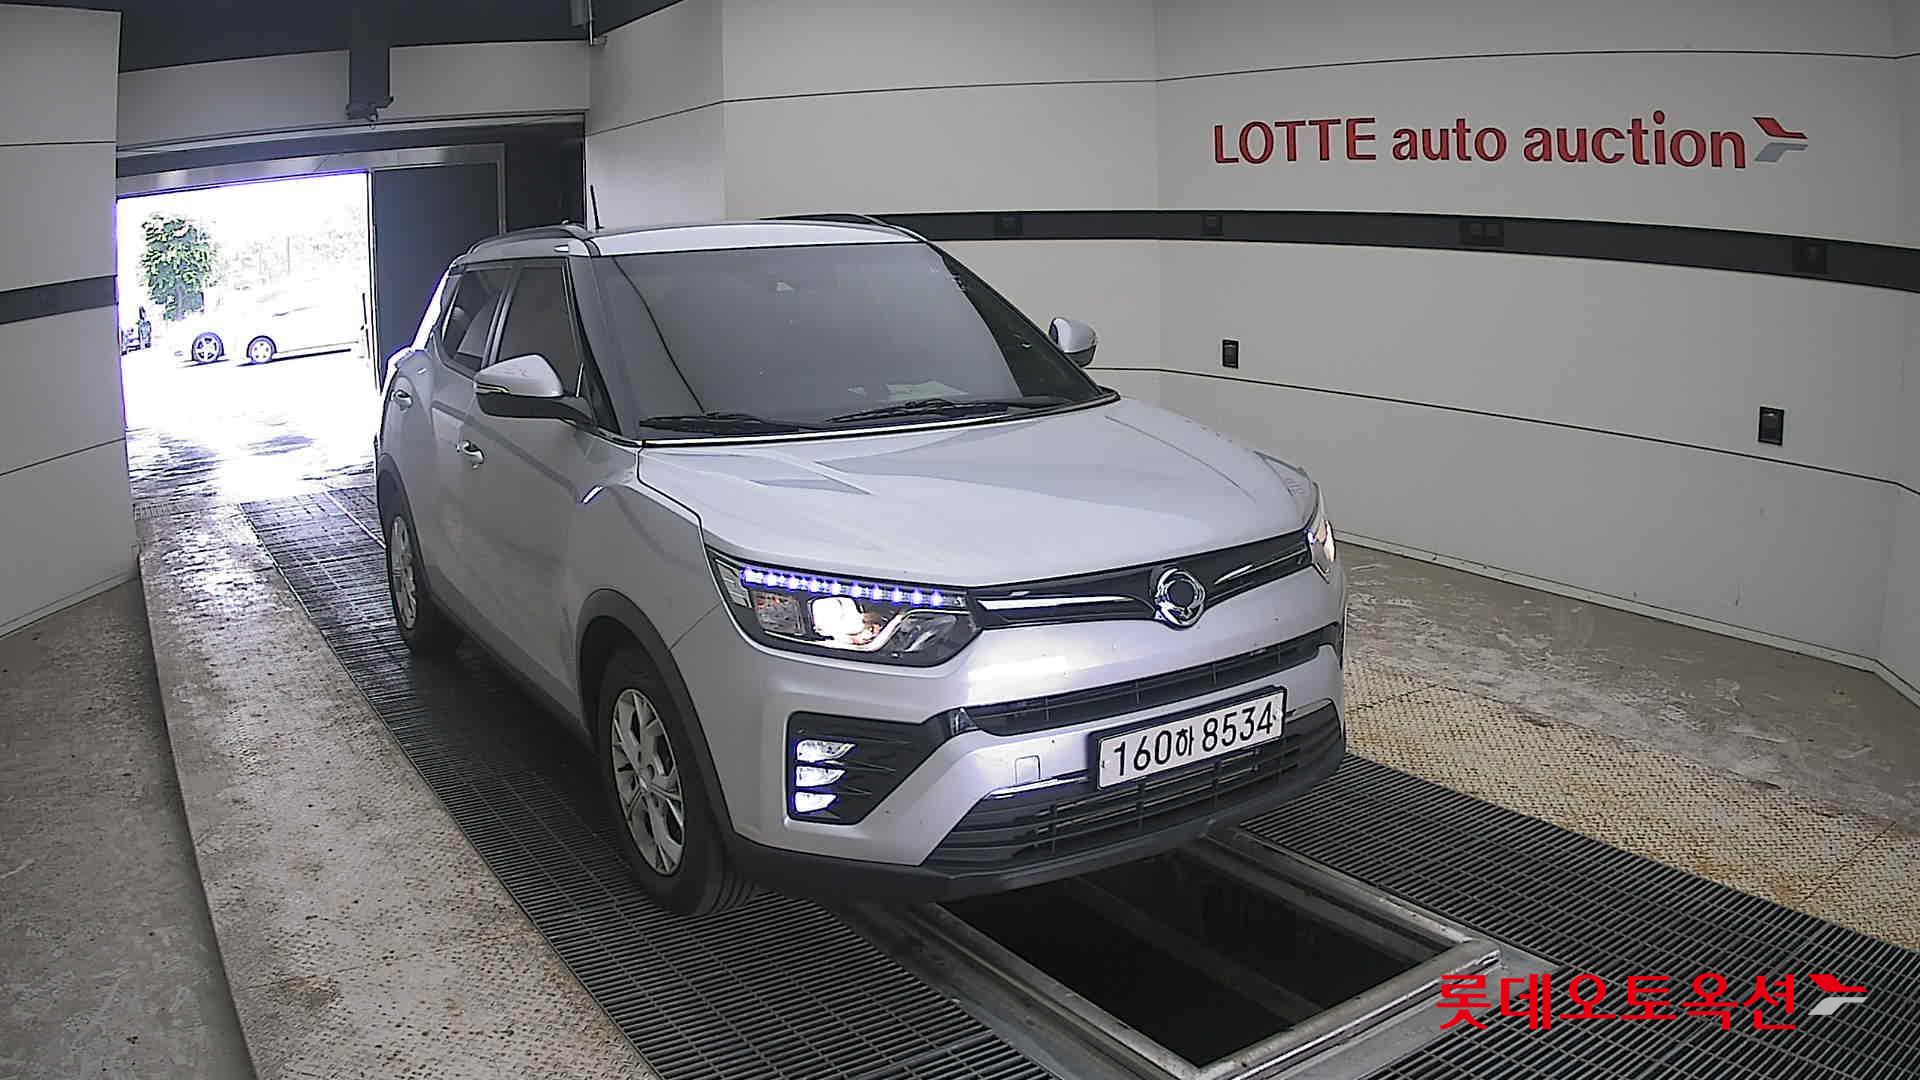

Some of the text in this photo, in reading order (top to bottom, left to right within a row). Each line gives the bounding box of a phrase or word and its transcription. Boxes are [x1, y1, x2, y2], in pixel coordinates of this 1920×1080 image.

[1213, 110, 1747, 169] LOTTE auto auction
[1114, 701, 1274, 776] 160하 8534
